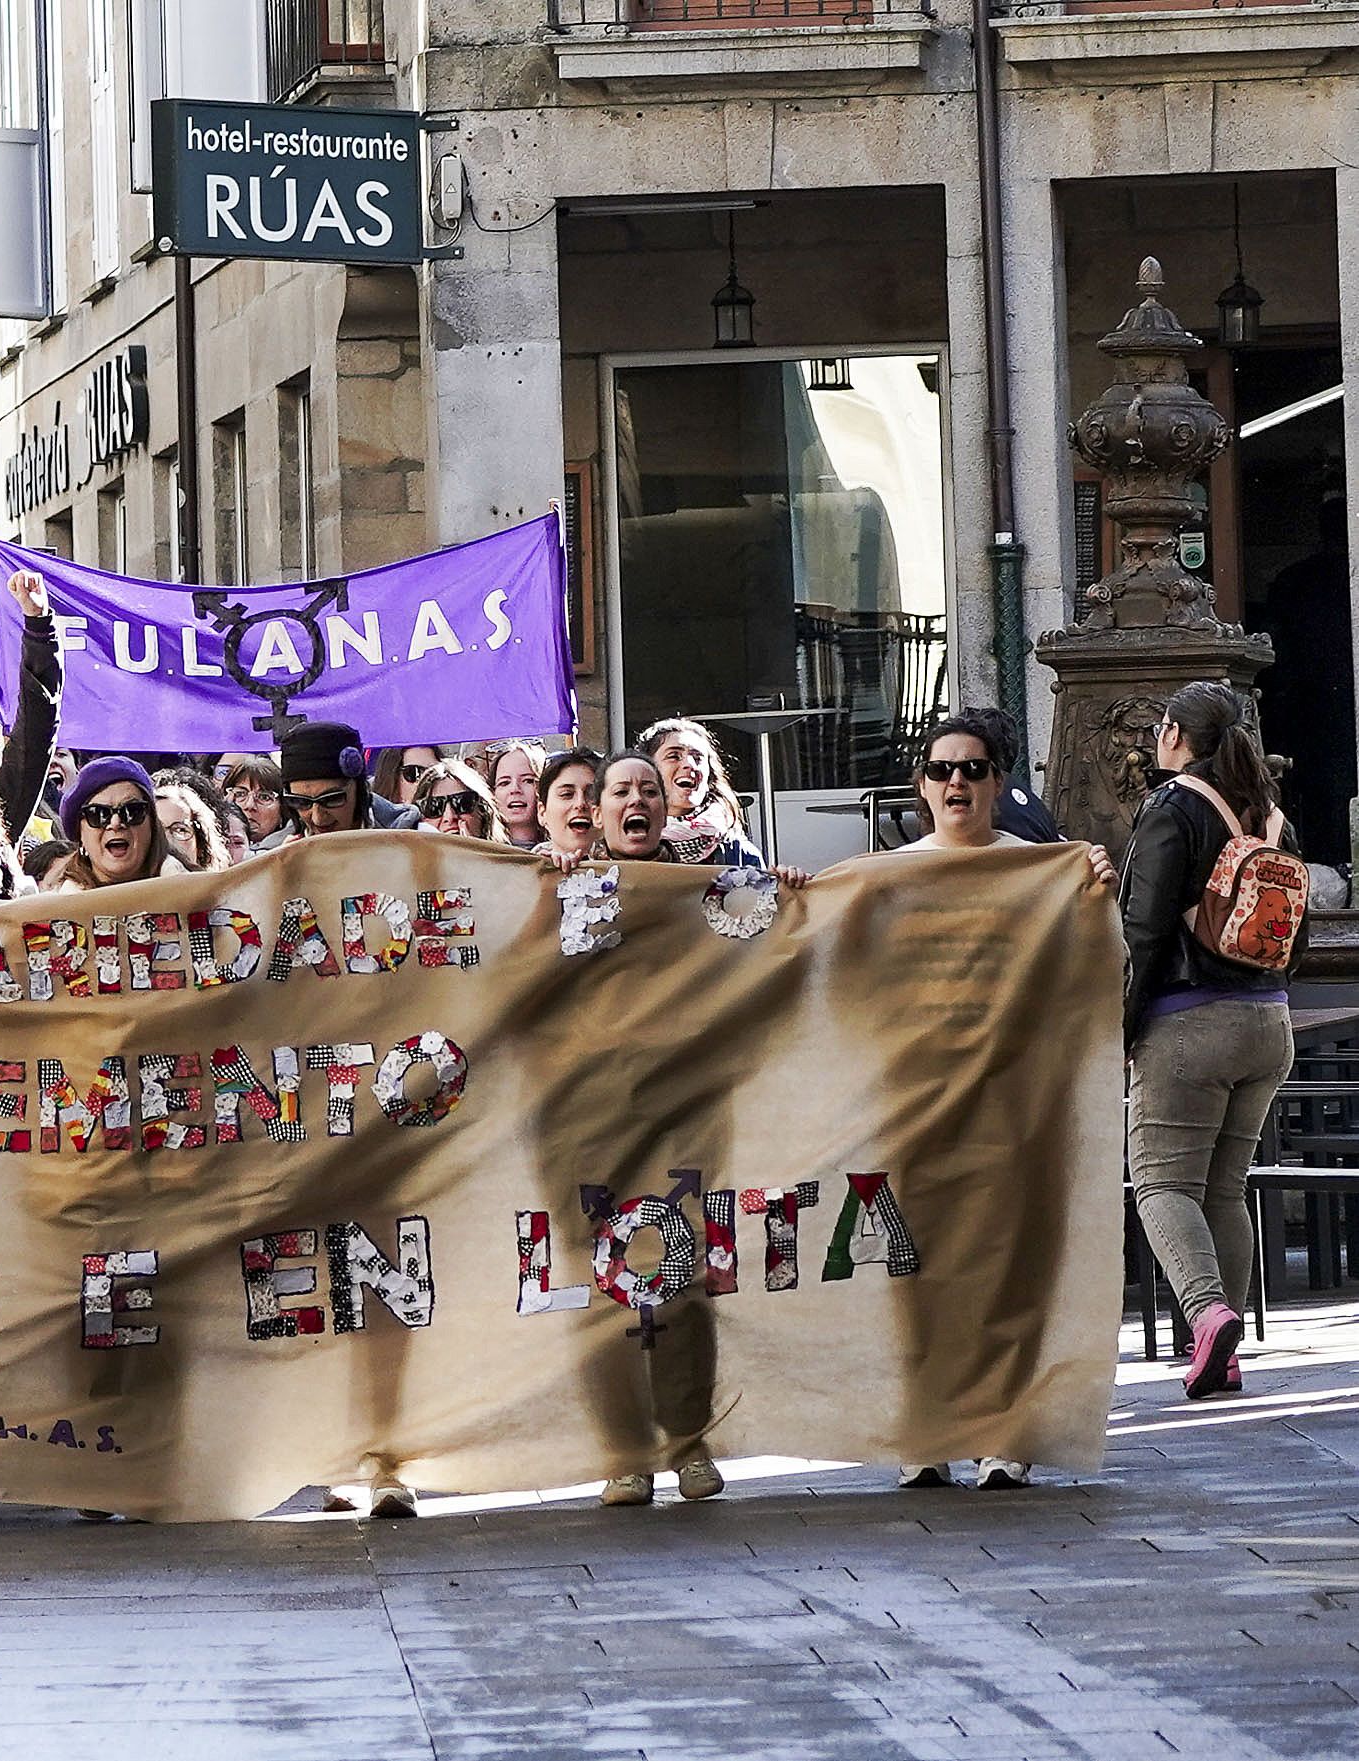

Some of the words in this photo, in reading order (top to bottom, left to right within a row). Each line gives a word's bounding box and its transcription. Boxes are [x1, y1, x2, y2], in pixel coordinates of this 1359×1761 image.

[186, 115, 409, 162] hotel-restaurante
[205, 165, 393, 247] RÚAS
[557, 864, 624, 957] E
[702, 865, 780, 939] O
[80, 1249, 161, 1350] E
[240, 1214, 434, 1342] EN
[515, 1171, 920, 1317] LOITA
